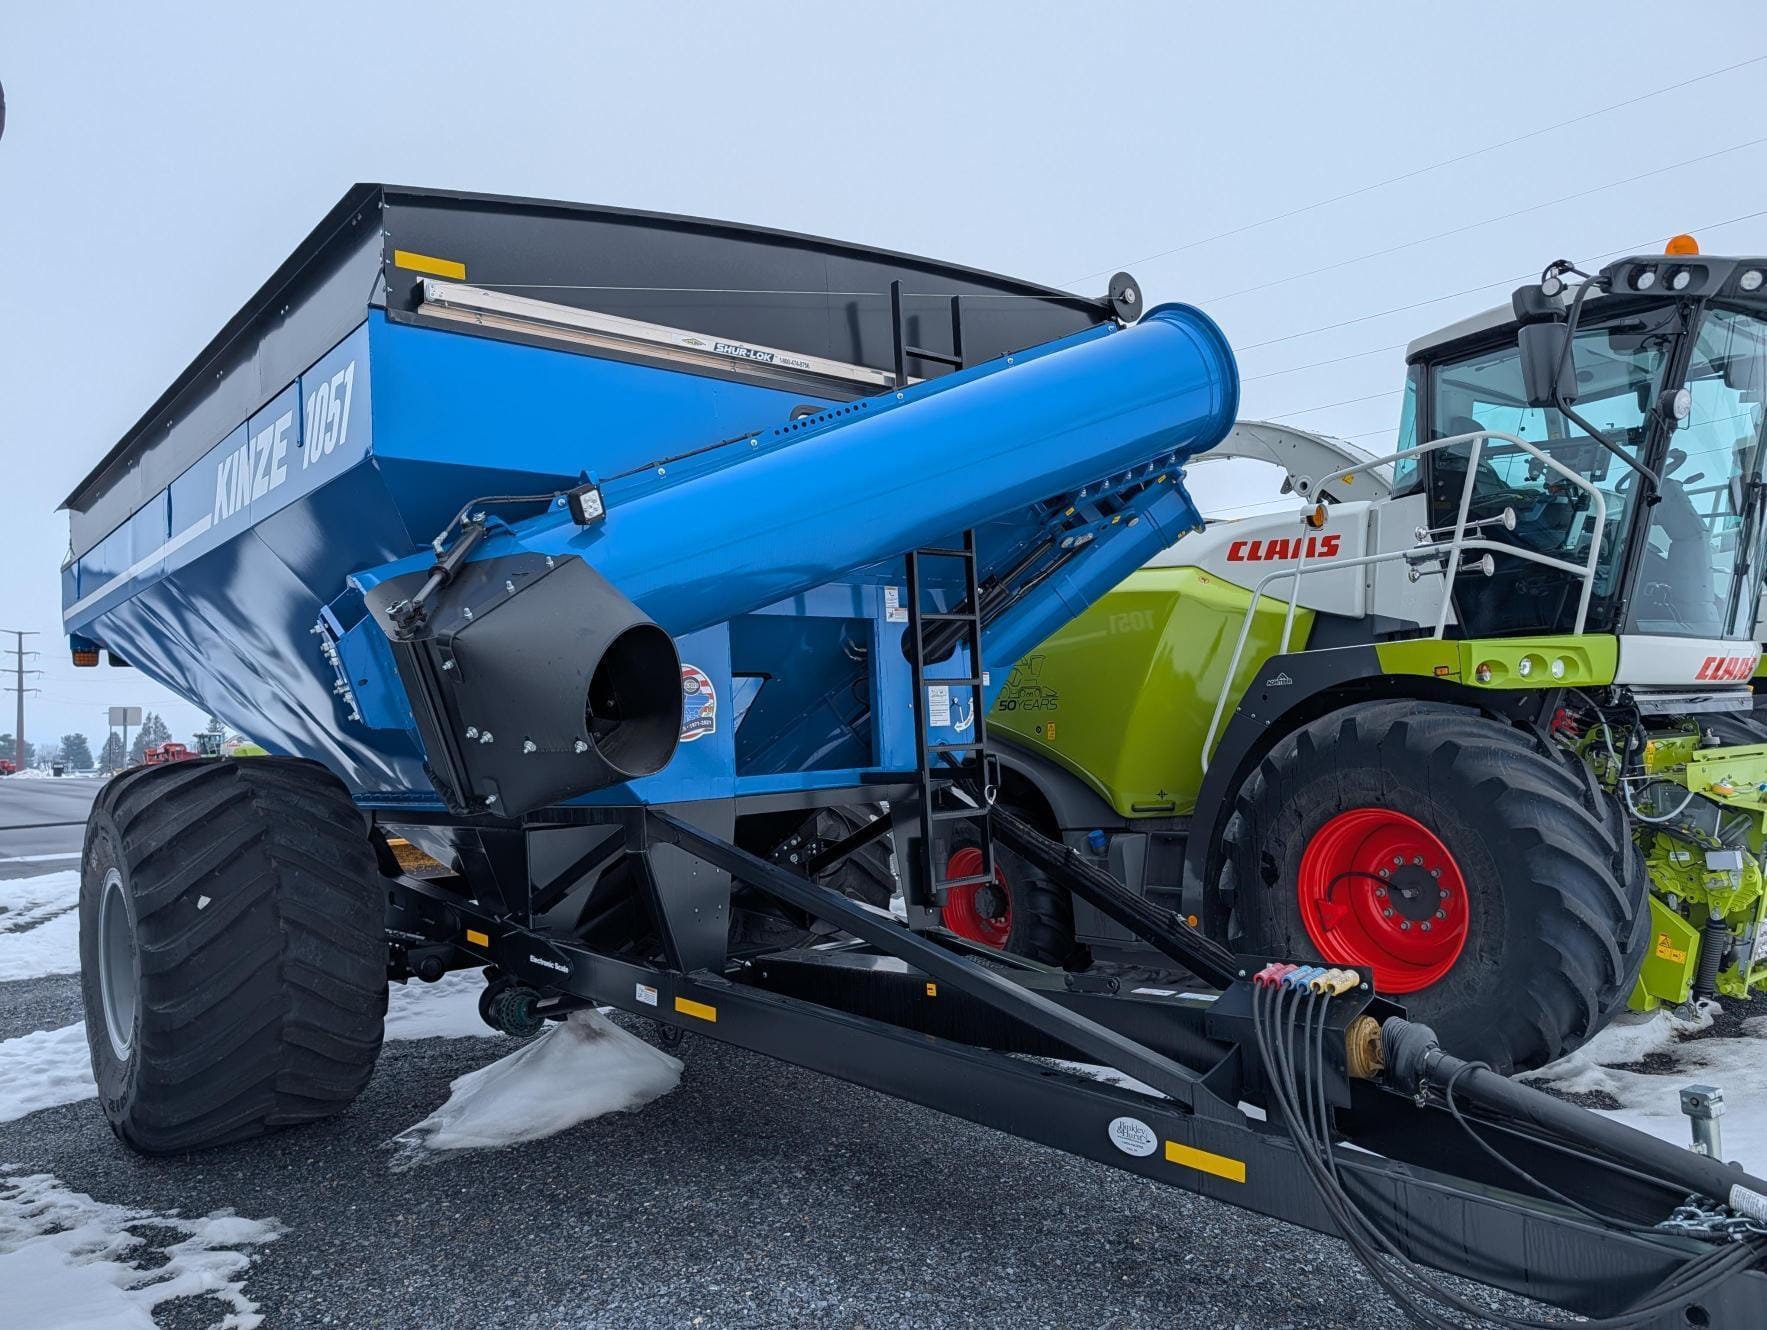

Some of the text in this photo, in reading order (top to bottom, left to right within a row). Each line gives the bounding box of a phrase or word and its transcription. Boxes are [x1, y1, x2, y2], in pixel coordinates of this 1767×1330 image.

[213, 360, 355, 526] KINZE 1051
[1226, 534, 1341, 562] CLAAS
[1695, 656, 1757, 681] CLAAS
